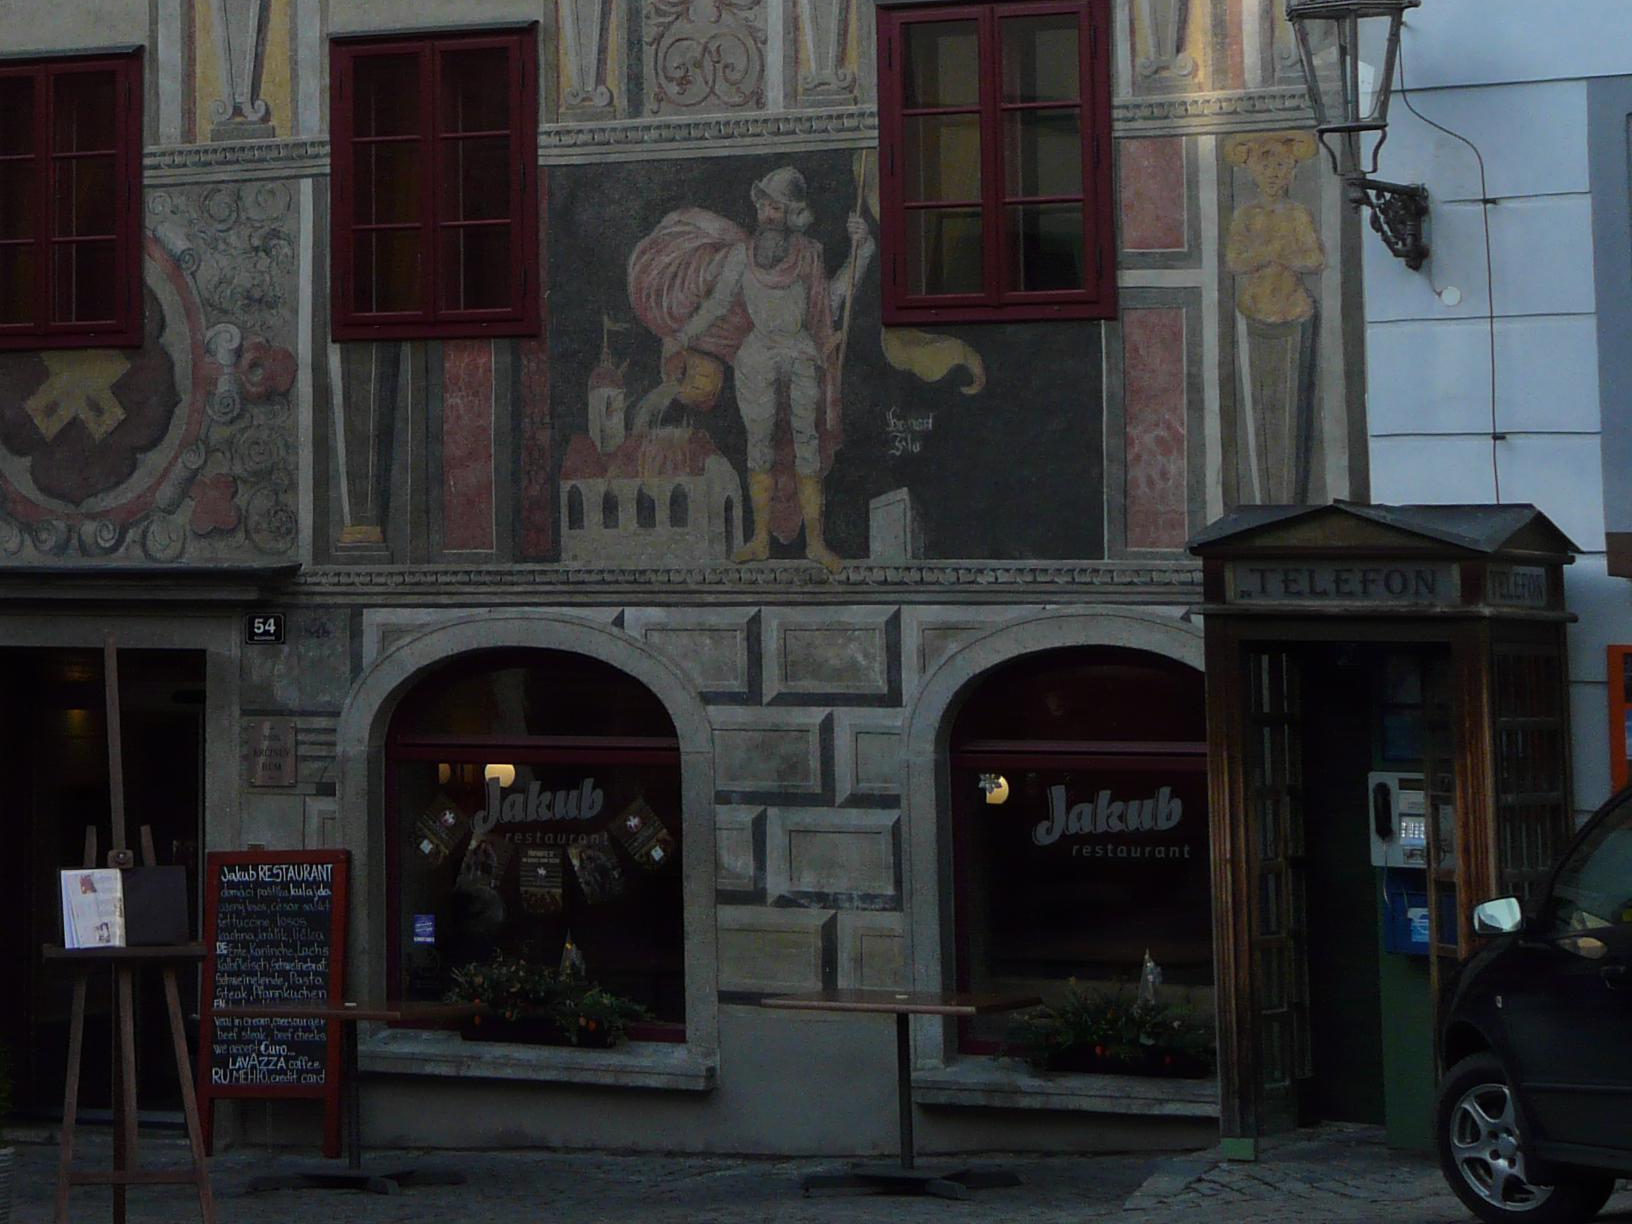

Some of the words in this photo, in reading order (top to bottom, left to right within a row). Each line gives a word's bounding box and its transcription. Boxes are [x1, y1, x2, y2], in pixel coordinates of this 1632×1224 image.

[1249, 567, 1441, 597] TELEFON
[1487, 569, 1544, 601] TELEFON
[254, 618, 276, 634] 54
[470, 776, 605, 834] Jakub
[1031, 784, 1184, 847] Jakub
[505, 831, 610, 845] restaurant
[1072, 842, 1192, 859] restaurant
[220, 864, 257, 882] Jakub
[258, 863, 334, 883] RESTAURANT
[290, 883, 332, 901] kulajda
[216, 941, 228, 954] DE
[229, 1053, 287, 1070] LAVAZZA
[288, 1056, 321, 1070] coffee
[212, 1067, 230, 1084] RU
[301, 1068, 326, 1084] card
